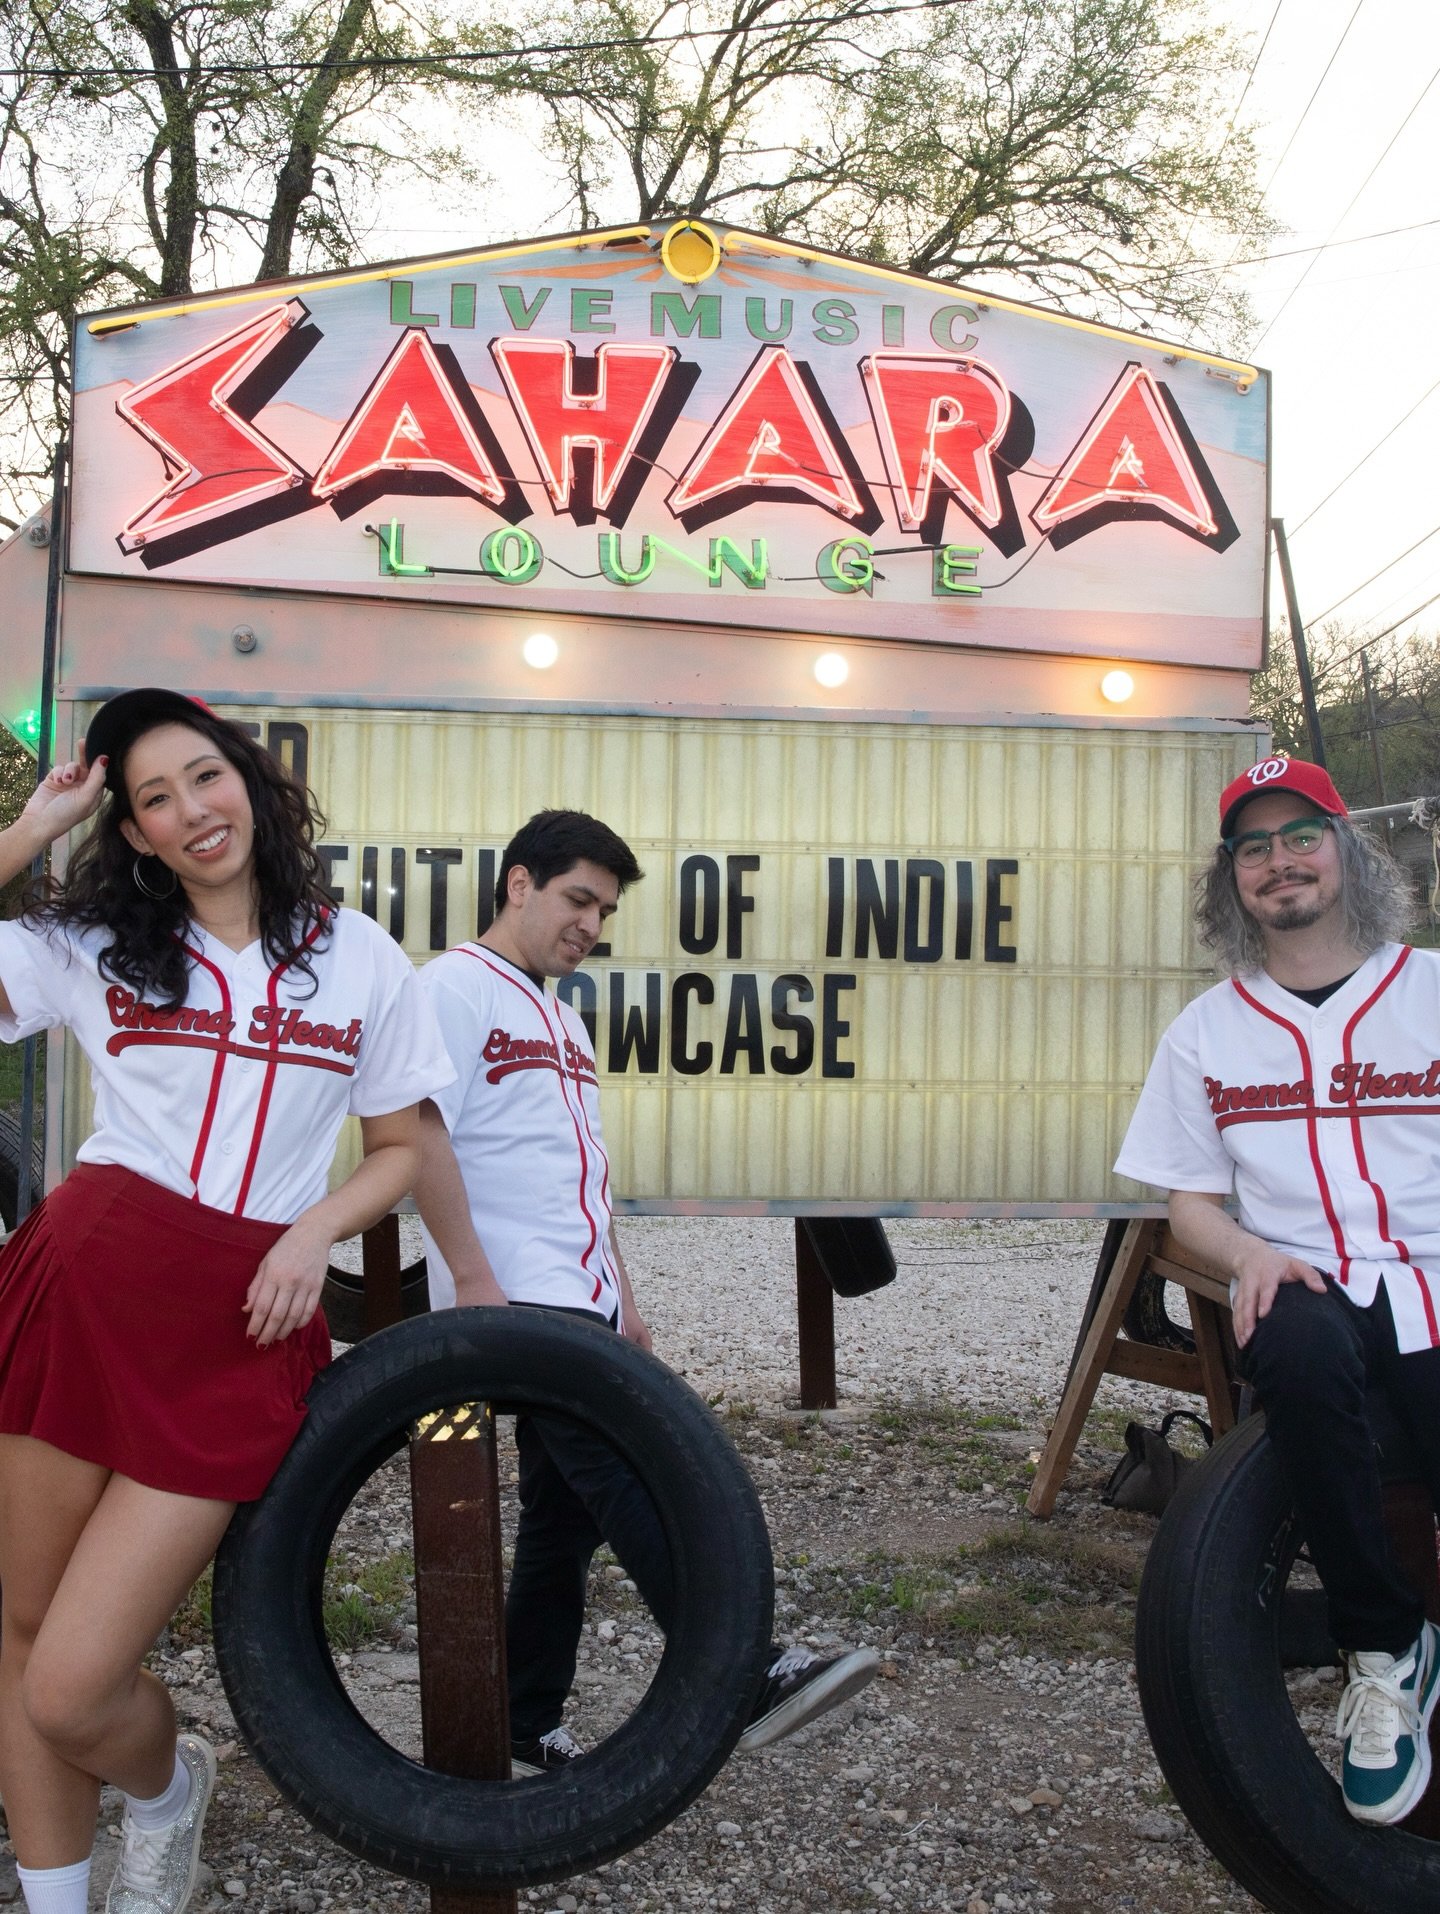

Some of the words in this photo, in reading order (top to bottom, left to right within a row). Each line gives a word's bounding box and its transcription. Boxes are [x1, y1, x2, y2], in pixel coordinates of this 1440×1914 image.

[389, 280, 616, 334] LIVE
[650, 291, 980, 352] MUSIC
[114, 296, 1240, 569] SAHARA
[378, 518, 984, 599] LOUNGE
[1247, 758, 1288, 785] W
[679, 854, 760, 959] OF
[825, 857, 1019, 963] INDIE
[106, 985, 236, 1035] Cinema
[247, 1005, 363, 1059] Heart
[1329, 1060, 1440, 1104] Heart
